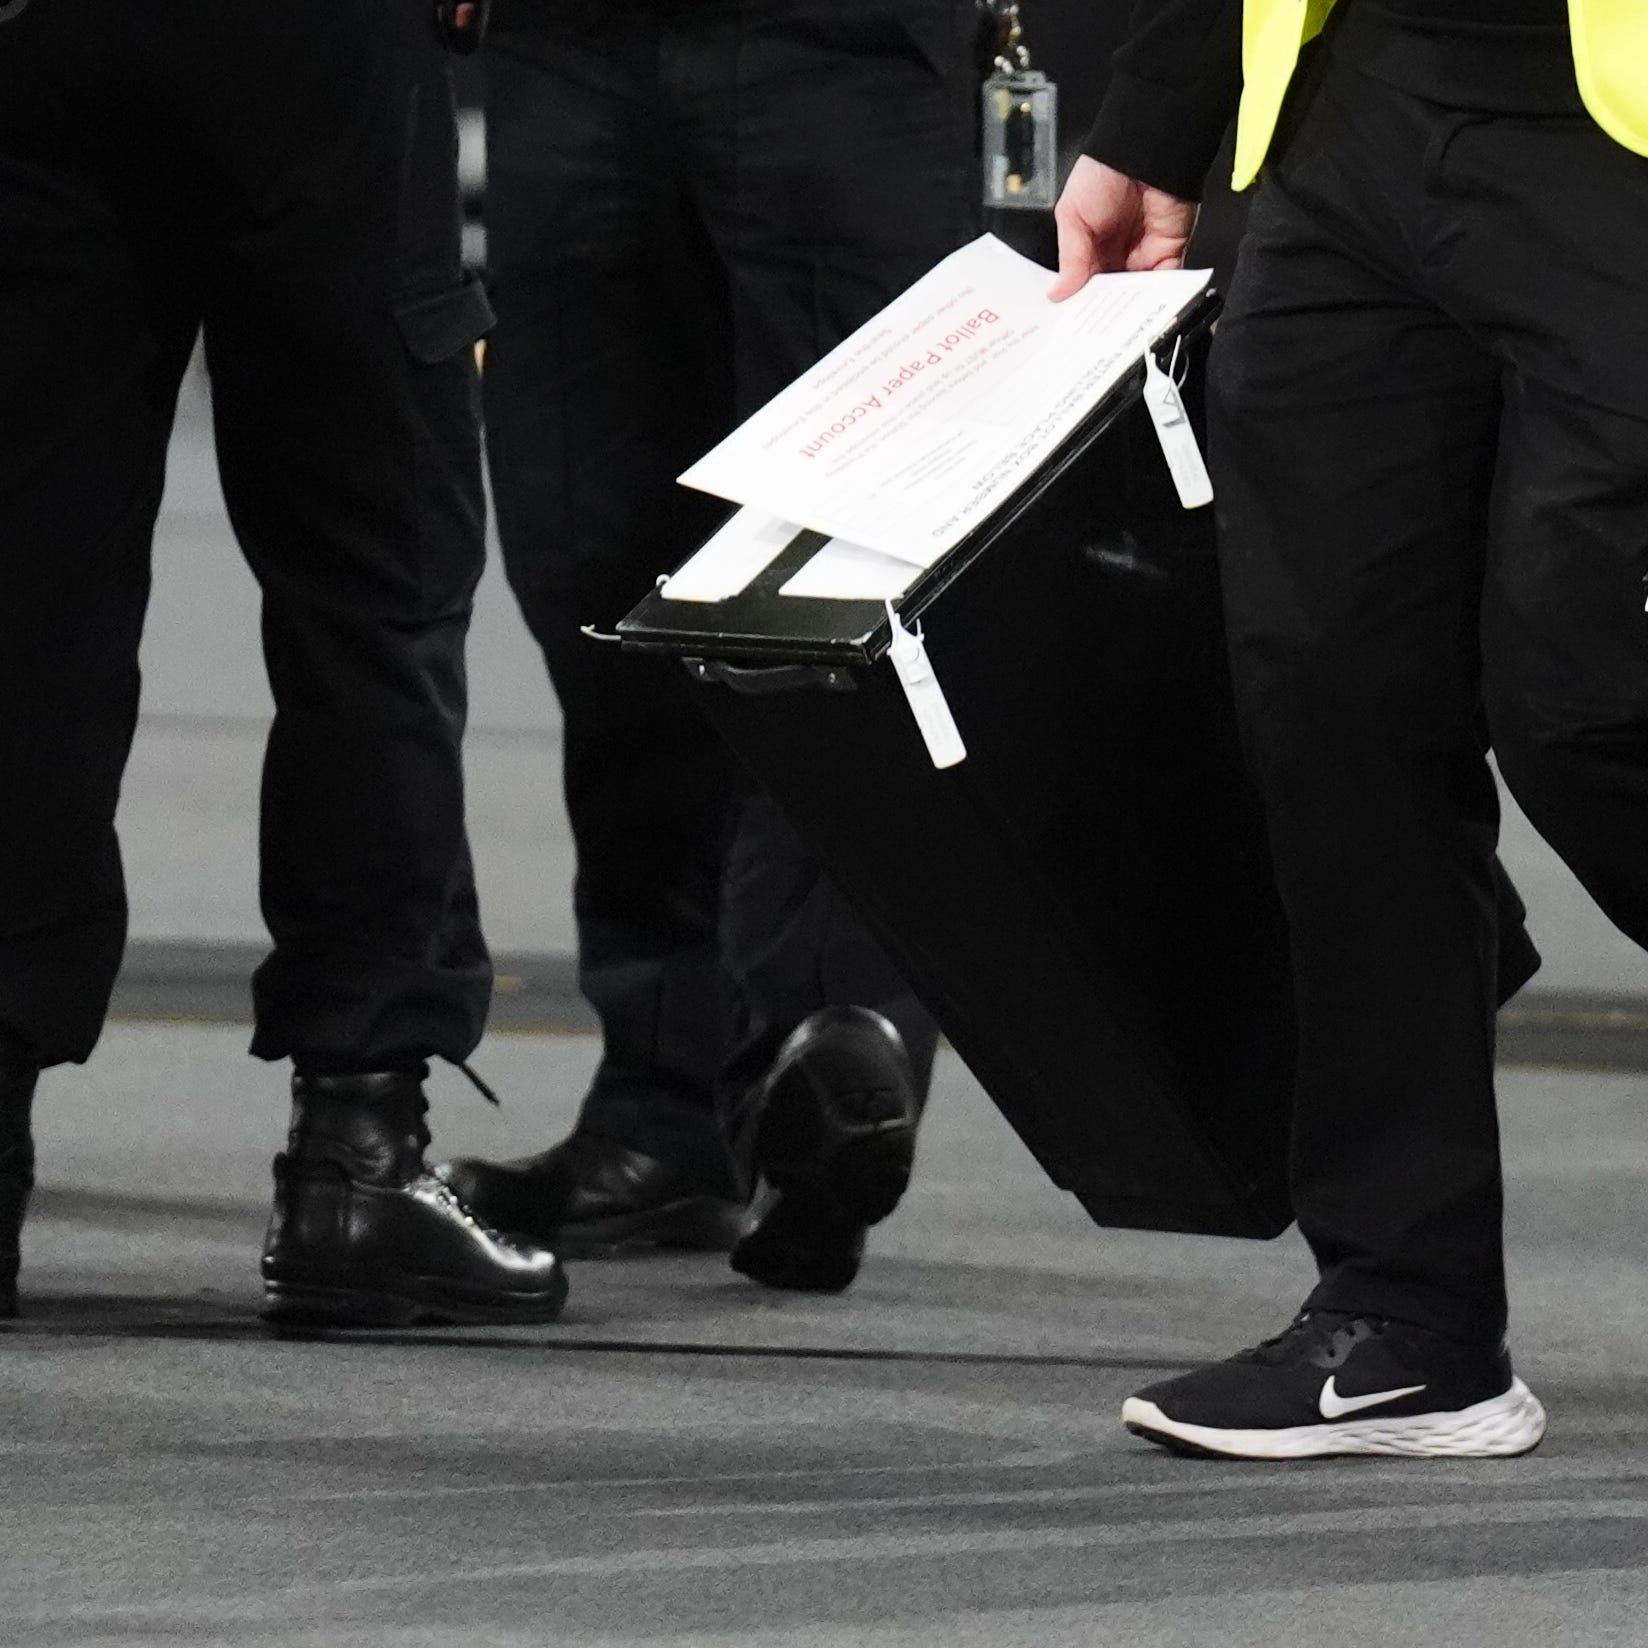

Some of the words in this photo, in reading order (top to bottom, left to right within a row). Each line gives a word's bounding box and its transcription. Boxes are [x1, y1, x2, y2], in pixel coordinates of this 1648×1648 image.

[935, 309, 1001, 351] Ballot
[878, 351, 944, 395] Paper
[799, 394, 882, 459] Account
[1011, 442, 1040, 466] BOX
[960, 468, 1013, 514] NUMBER
[929, 515, 961, 537] AND
